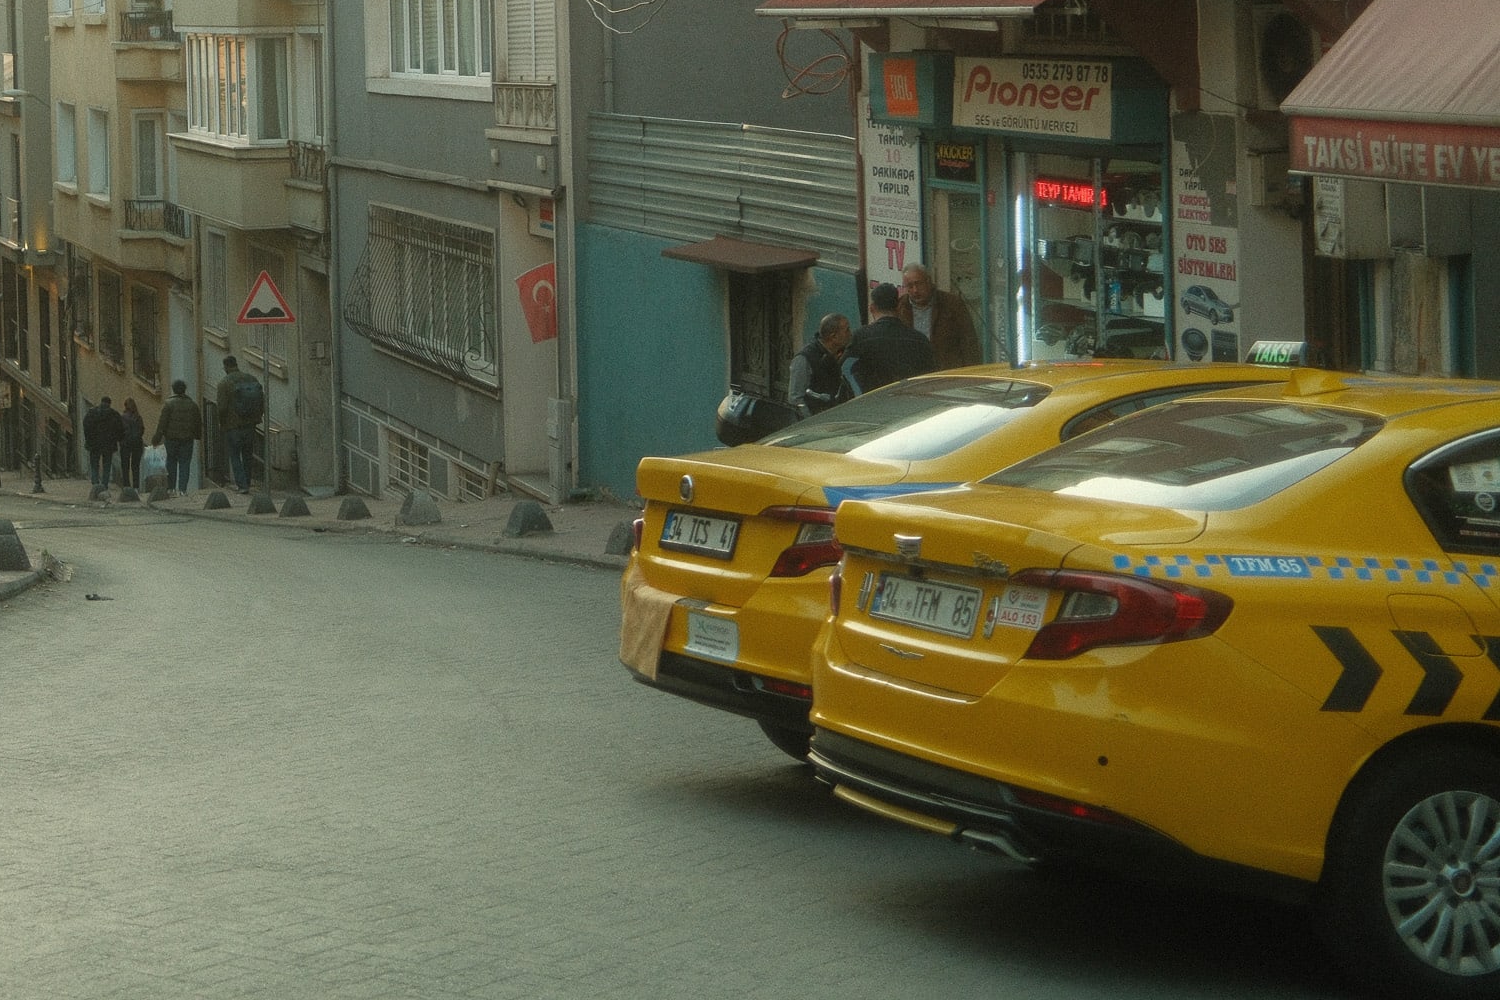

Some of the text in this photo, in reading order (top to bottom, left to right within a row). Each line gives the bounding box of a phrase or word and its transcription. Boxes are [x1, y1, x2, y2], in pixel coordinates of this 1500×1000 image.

[1022, 63, 1109, 83] 0535 279 87 78
[963, 65, 1100, 111] Pioneer
[974, 114, 1079, 134] SES ve GÖRÜNTÜ MERKEZİ
[1304, 131, 1365, 171] TAKSİ
[1369, 134, 1428, 177] BÜFE
[1433, 144, 1465, 179] EV
[878, 181, 910, 196] YAPILIR
[1037, 180, 1060, 200] TEYP
[872, 225, 888, 237] 0535
[888, 227, 901, 240] 279
[1185, 232, 1227, 255] OTO SES
[885, 238, 906, 272] TV
[1178, 253, 1237, 282] SİSTEMLERİ
[668, 516, 736, 549] 34 TCS 41
[1231, 557, 1302, 574] TFM 85
[881, 581, 975, 628] 34 TFM 85
[1001, 610, 1038, 625] ALO 153
